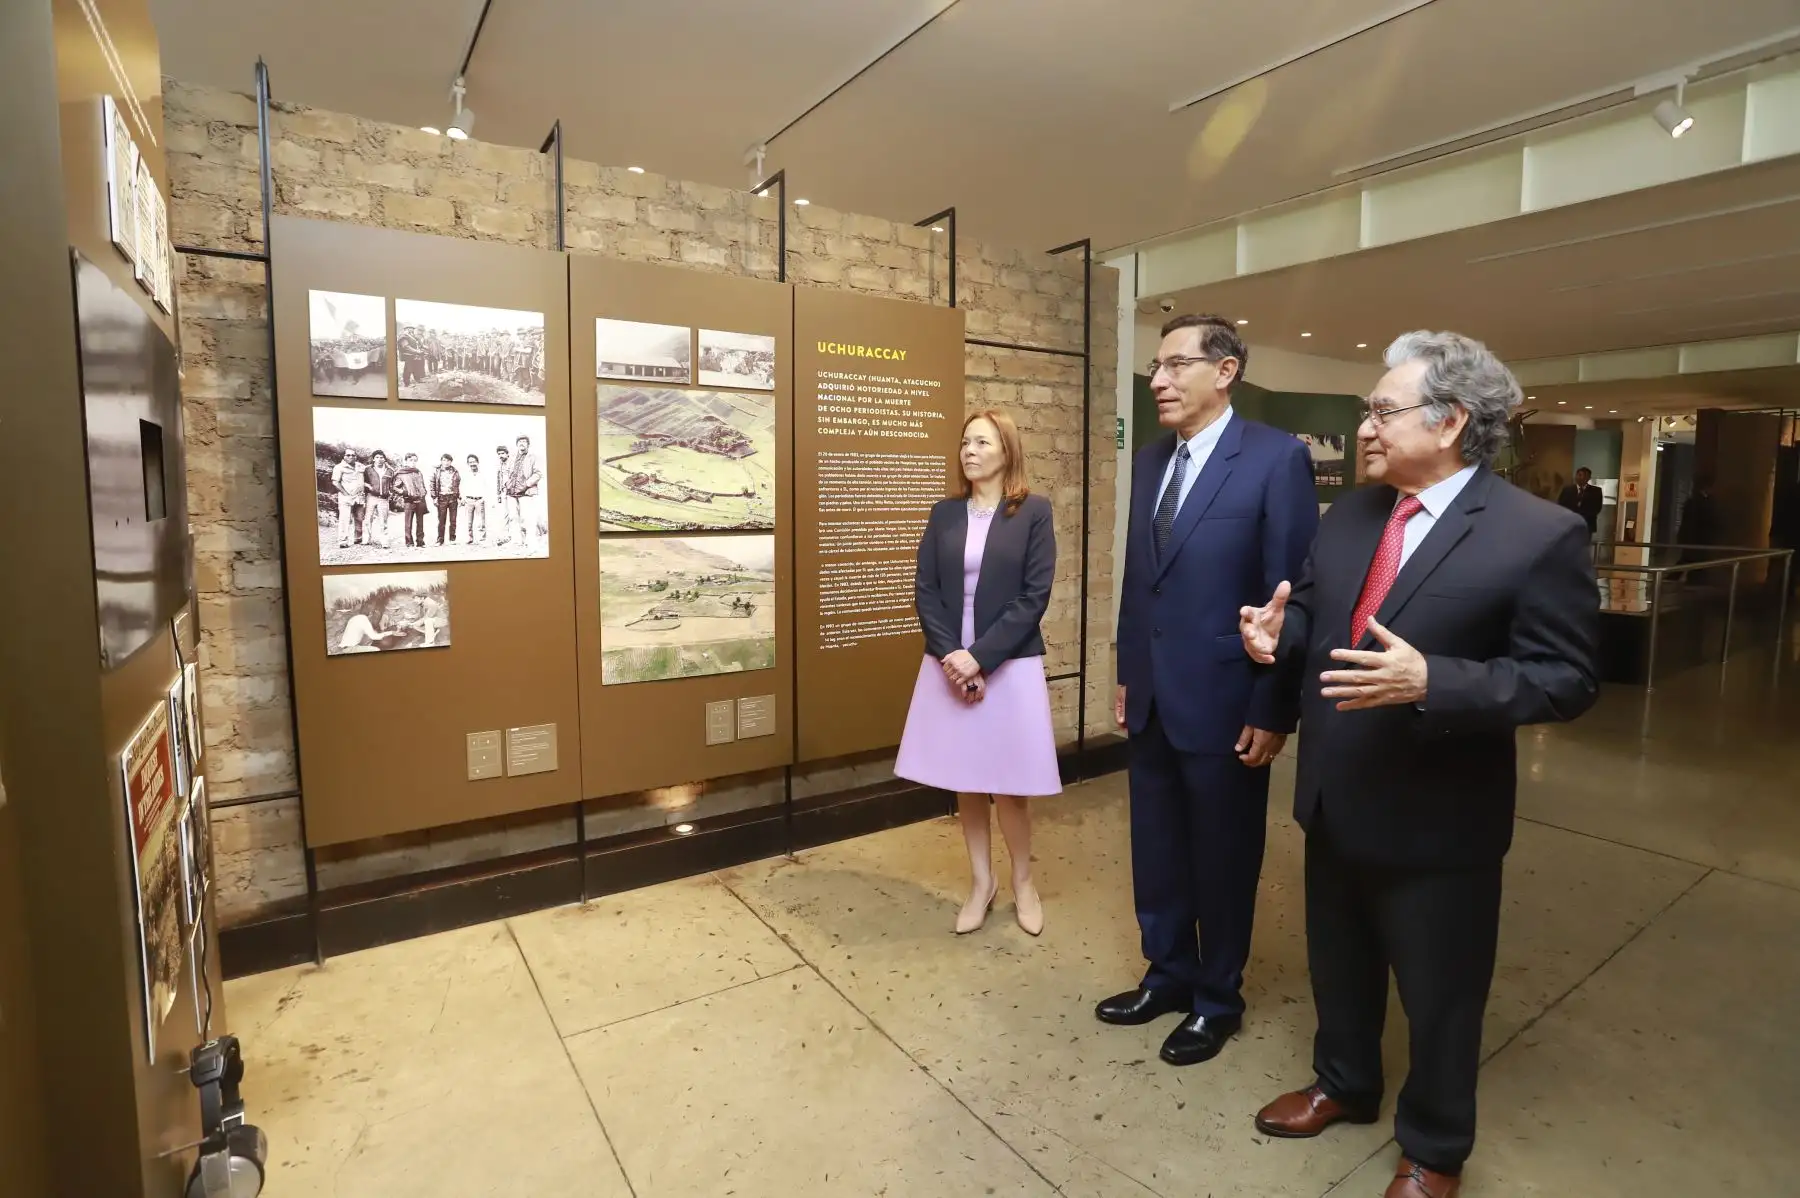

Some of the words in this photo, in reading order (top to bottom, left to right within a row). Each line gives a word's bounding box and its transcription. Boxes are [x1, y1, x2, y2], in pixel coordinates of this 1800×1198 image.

[817, 341, 906, 360] UCHURACCAY
[817, 371, 866, 381] UCHURACCAY
[869, 375, 901, 384] (HUANTA,
[903, 378, 941, 388] AYACUCHO)
[818, 383, 854, 392] ADQUIRIÓ
[857, 386, 902, 395] NOTORIEDAD
[818, 394, 855, 403] NACIONAL
[854, 408, 900, 416] PERIODISTAS.
[913, 411, 945, 419] HISTORIA,
[832, 417, 870, 426] EMBARGO,
[909, 420, 923, 428] MÁS
[864, 429, 878, 437] AÚN
[881, 430, 929, 438] DESCONOCIDA
